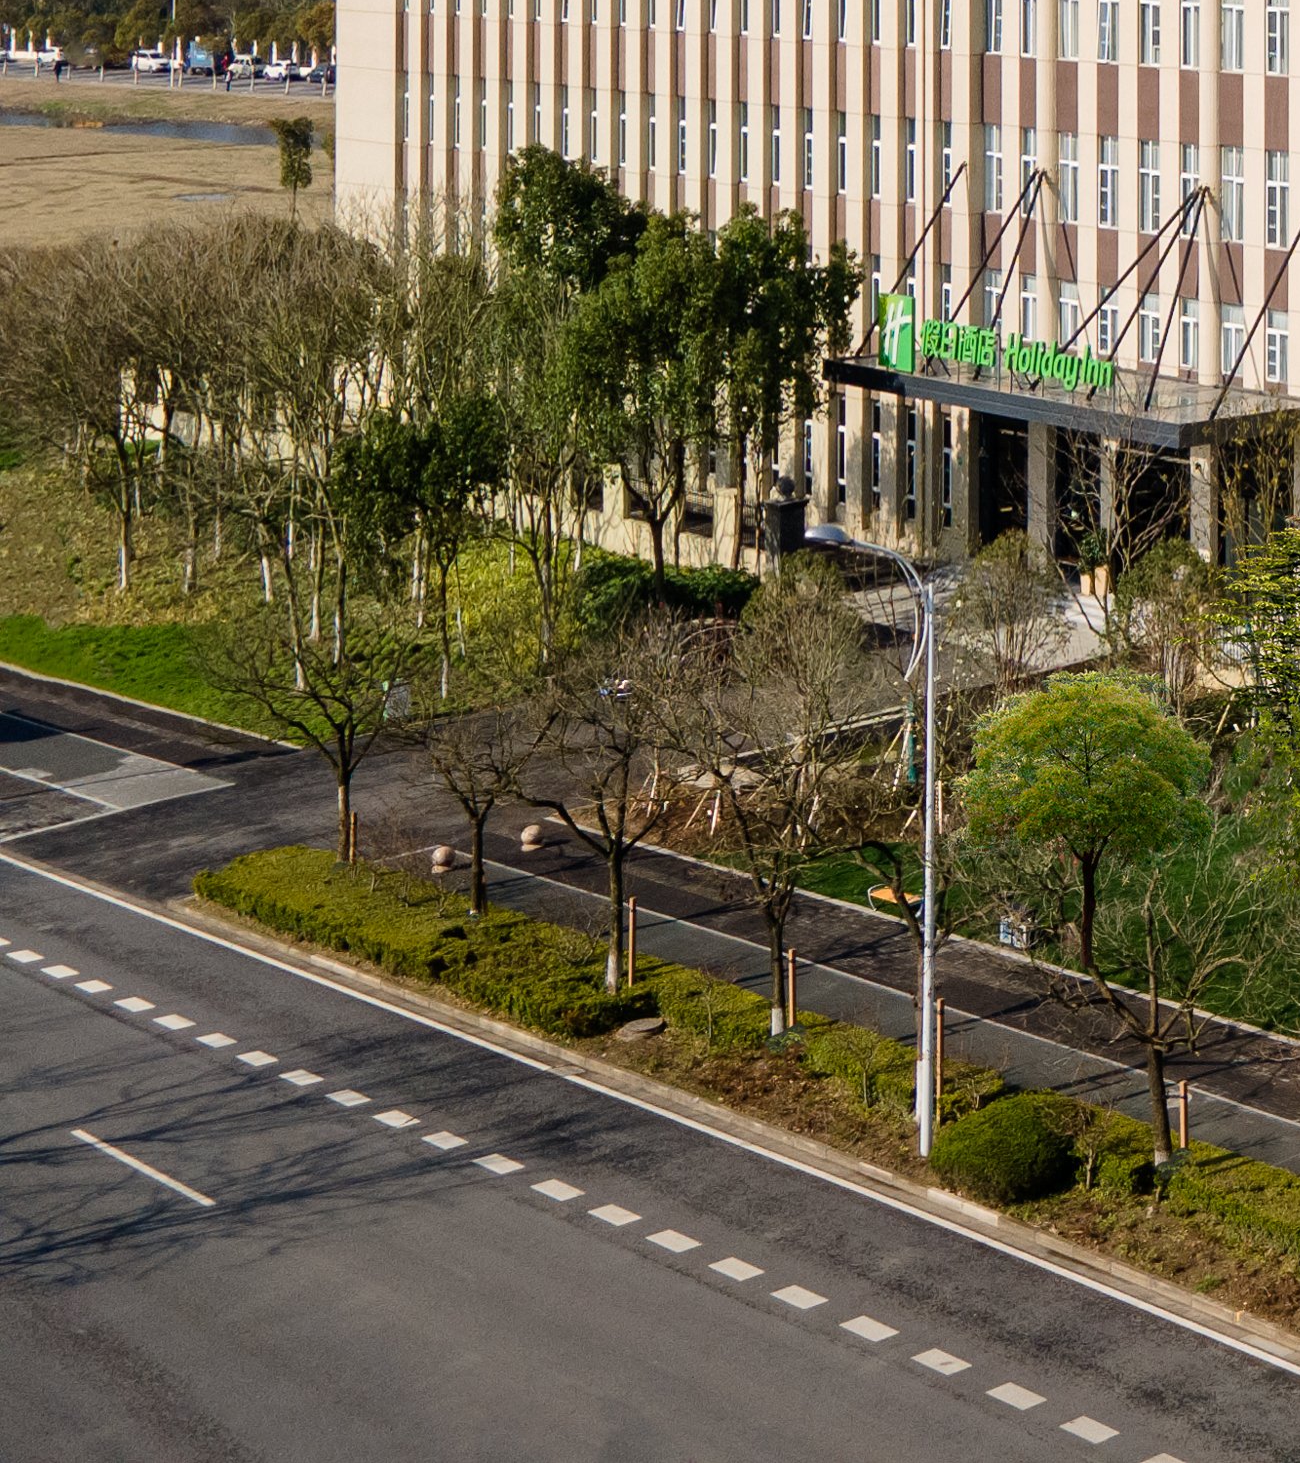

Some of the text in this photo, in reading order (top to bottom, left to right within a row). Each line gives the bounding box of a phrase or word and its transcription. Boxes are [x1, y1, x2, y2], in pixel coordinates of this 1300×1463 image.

[920, 319, 997, 368] 假日酒店
[1004, 333, 1115, 393] Holiday Inn
